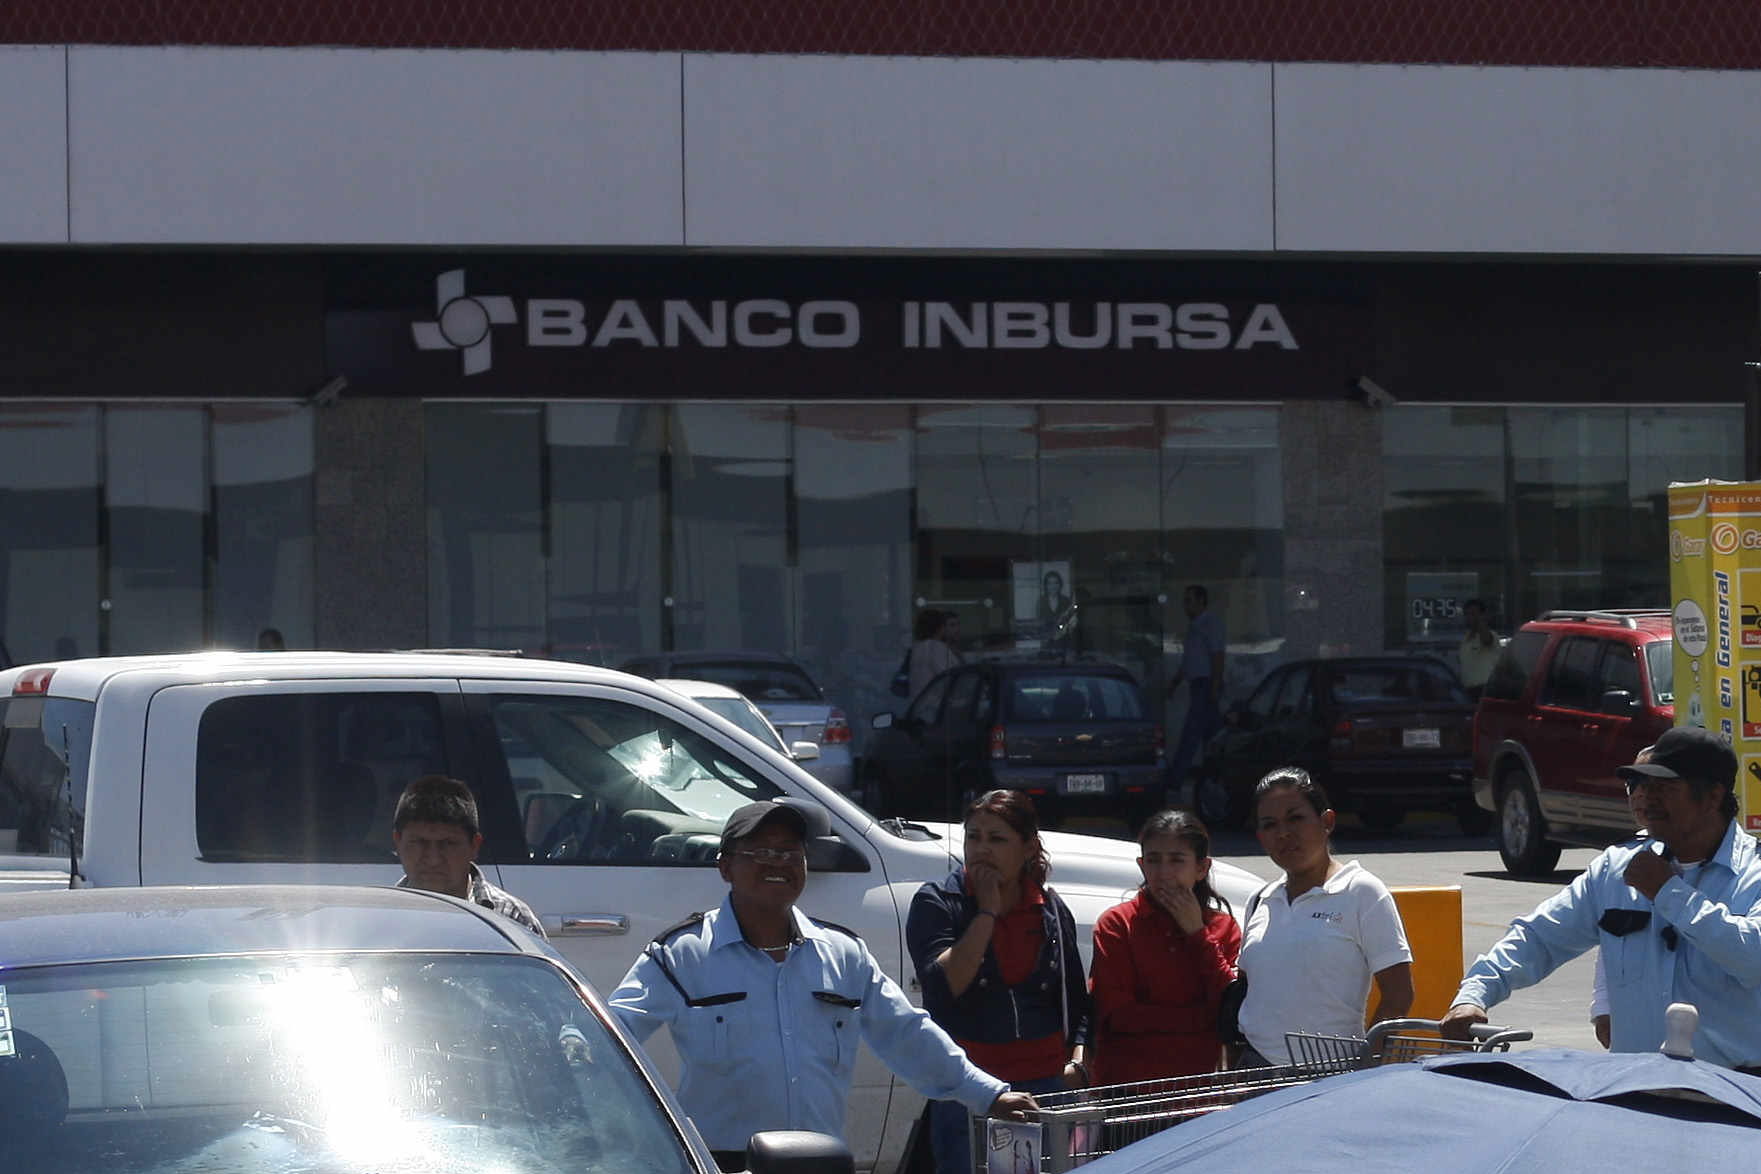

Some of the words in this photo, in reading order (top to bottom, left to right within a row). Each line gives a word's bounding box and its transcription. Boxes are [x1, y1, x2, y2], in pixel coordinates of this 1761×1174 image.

[527, 299, 861, 348] BANCO
[904, 301, 1299, 350] INBURSA
[1715, 571, 1730, 668] General
[1720, 678, 1731, 709] en
